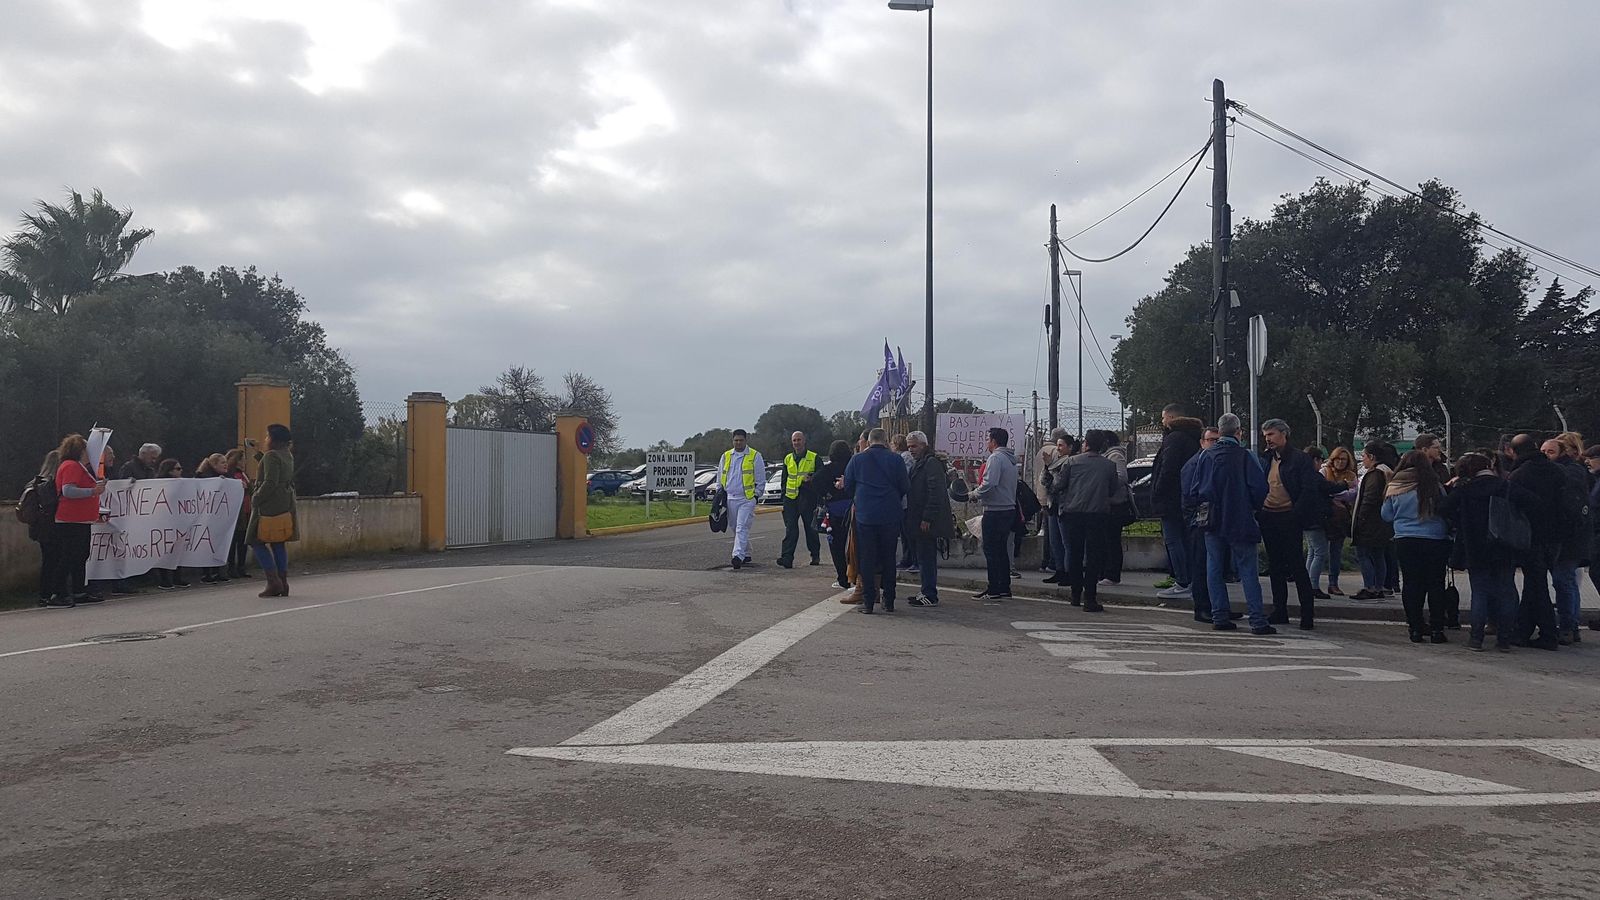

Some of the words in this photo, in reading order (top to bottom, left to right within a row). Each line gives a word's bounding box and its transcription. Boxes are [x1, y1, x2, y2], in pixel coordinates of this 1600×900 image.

[949, 416, 987, 429] BASTA
[999, 414, 1014, 427] YA
[947, 428, 1015, 443] QUERES
[648, 454, 666, 463] ZONA
[667, 454, 693, 463] MILITAR
[653, 466, 688, 476] PROHIBIDO
[656, 478, 685, 487] APARCAR
[178, 499, 196, 515] NOS
[196, 489, 230, 517] MATA
[150, 524, 215, 558] REMATA
